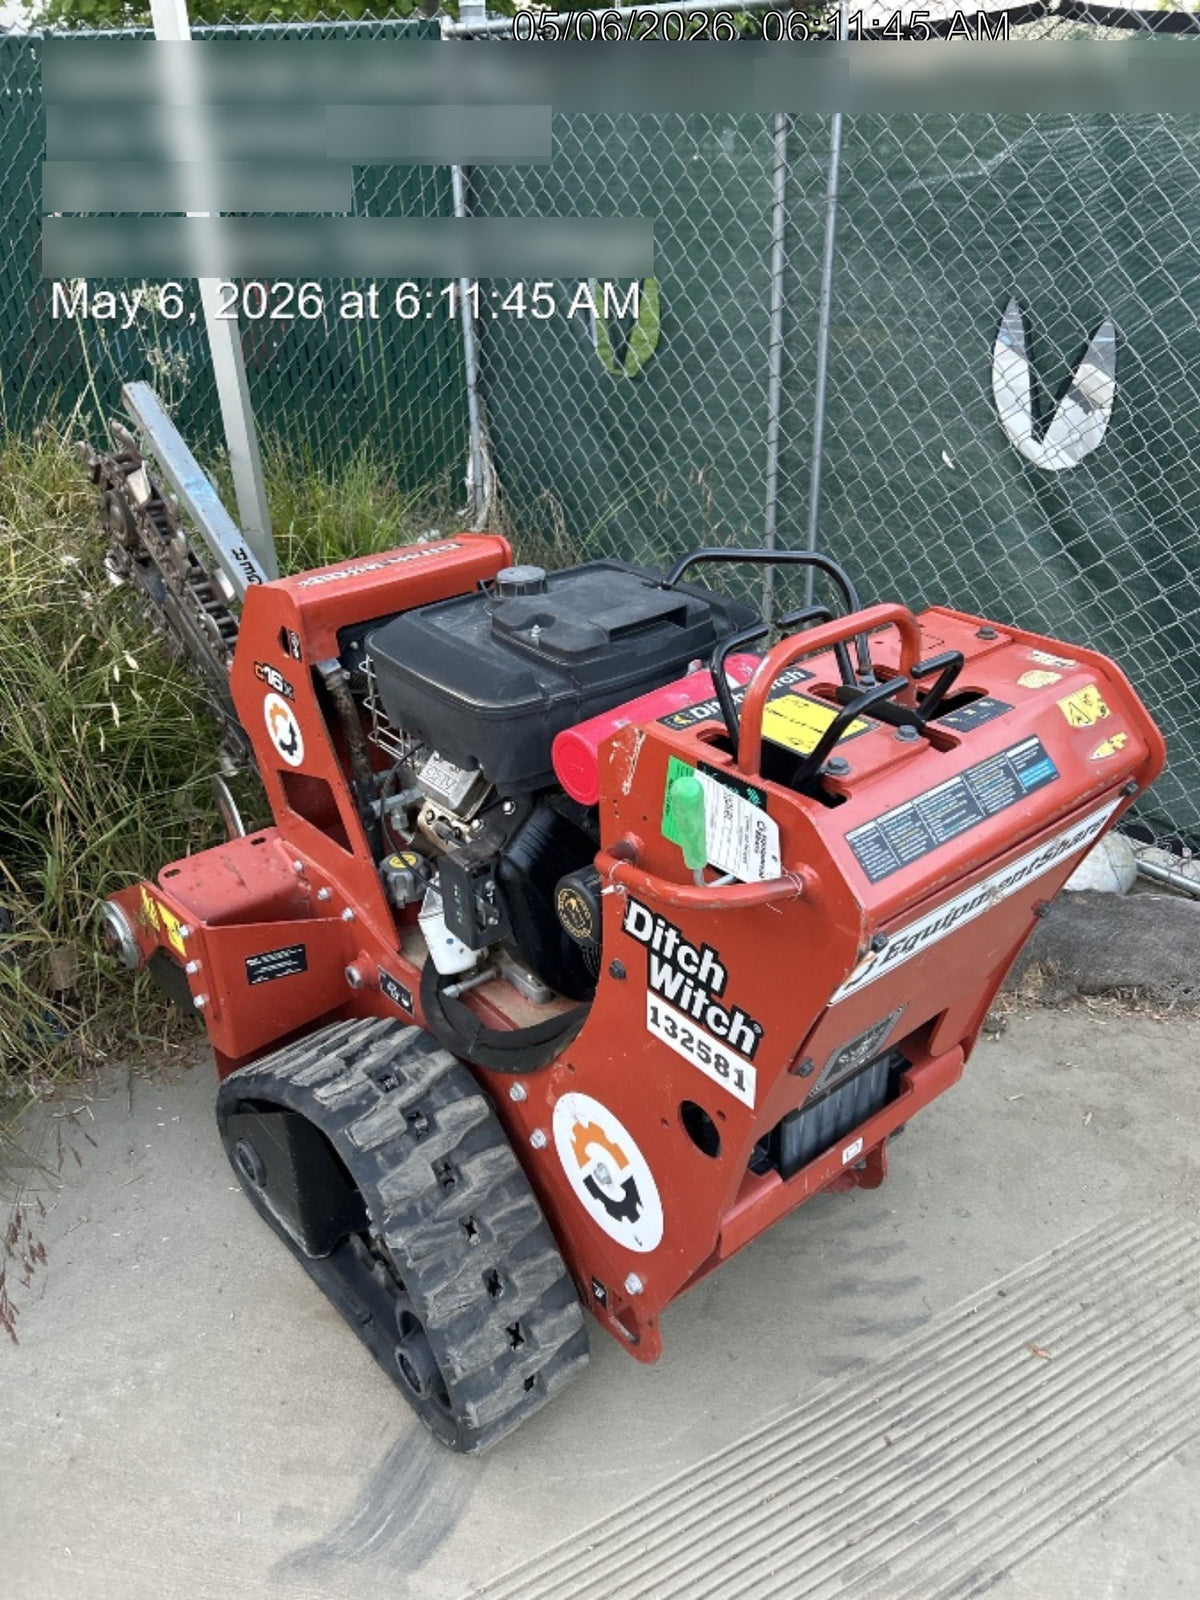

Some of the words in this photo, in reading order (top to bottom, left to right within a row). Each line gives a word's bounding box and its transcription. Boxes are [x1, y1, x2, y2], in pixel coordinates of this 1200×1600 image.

[691, 692, 745, 721] Dith
[624, 899, 725, 992] Ditch
[650, 1005, 745, 1092] 132581
